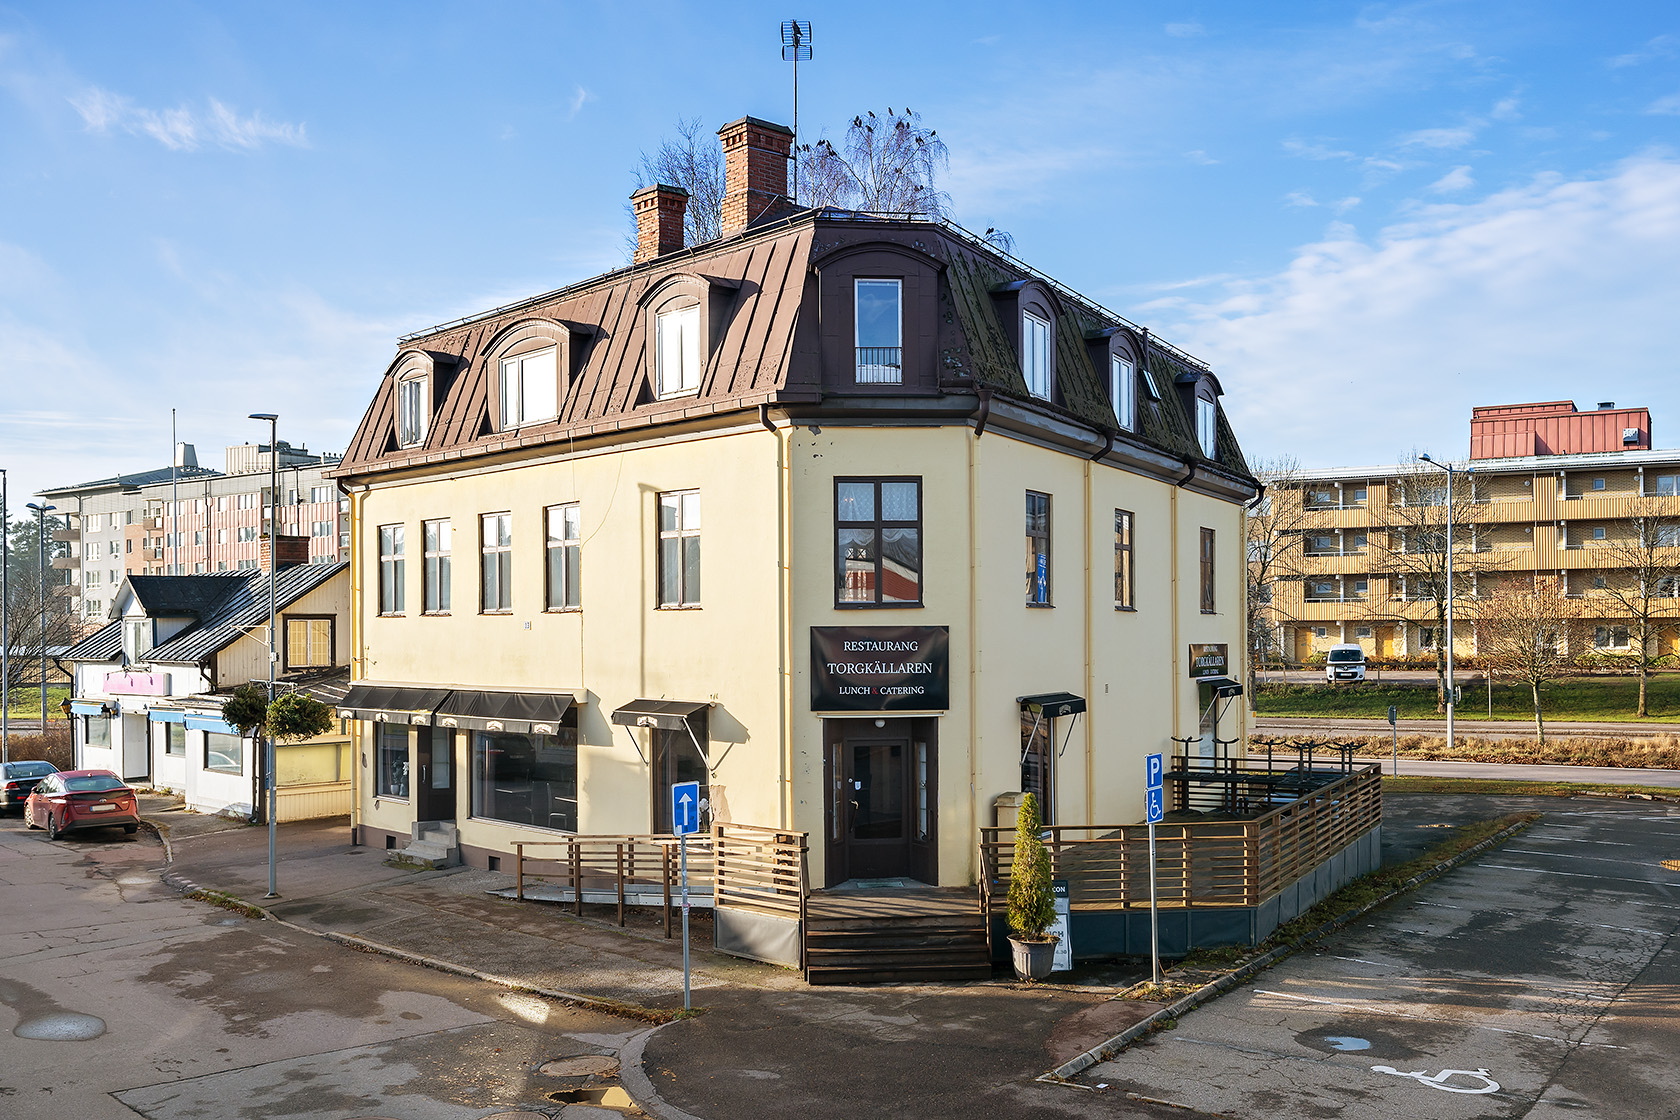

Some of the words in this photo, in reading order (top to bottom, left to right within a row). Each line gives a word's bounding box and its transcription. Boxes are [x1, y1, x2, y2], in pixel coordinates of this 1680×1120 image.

[843, 641, 919, 652] RESTAURANG
[827, 660, 933, 675] TORGKÄLLAREN
[839, 686, 871, 695] LUNCH
[871, 687, 878, 695] &
[879, 686, 925, 695] CATERING
[1150, 757, 1160, 785] P
